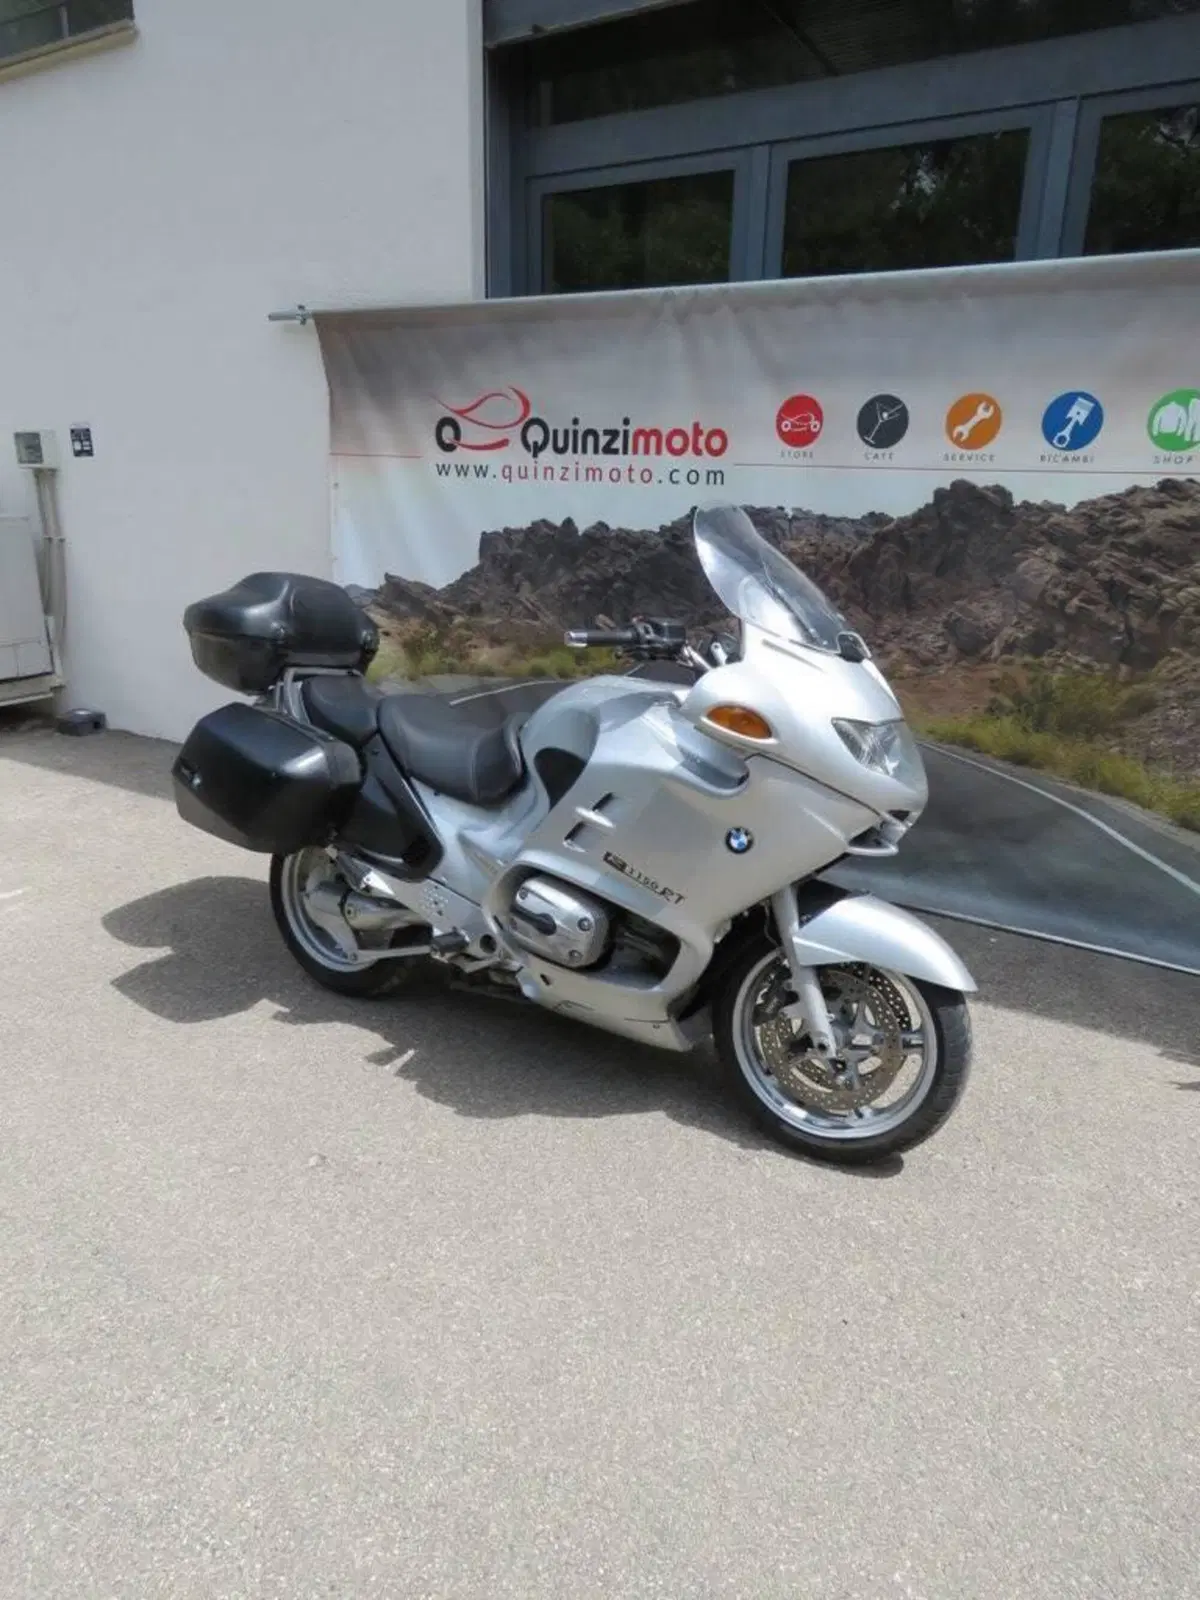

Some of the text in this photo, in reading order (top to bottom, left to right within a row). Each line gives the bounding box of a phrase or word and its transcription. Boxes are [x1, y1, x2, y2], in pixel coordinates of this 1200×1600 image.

[520, 416, 729, 458] Quinzimoto
[942, 452, 996, 463] SERVICE
[1151, 454, 1194, 465] SHOP
[436, 460, 725, 486] www.quinzimoto.com
